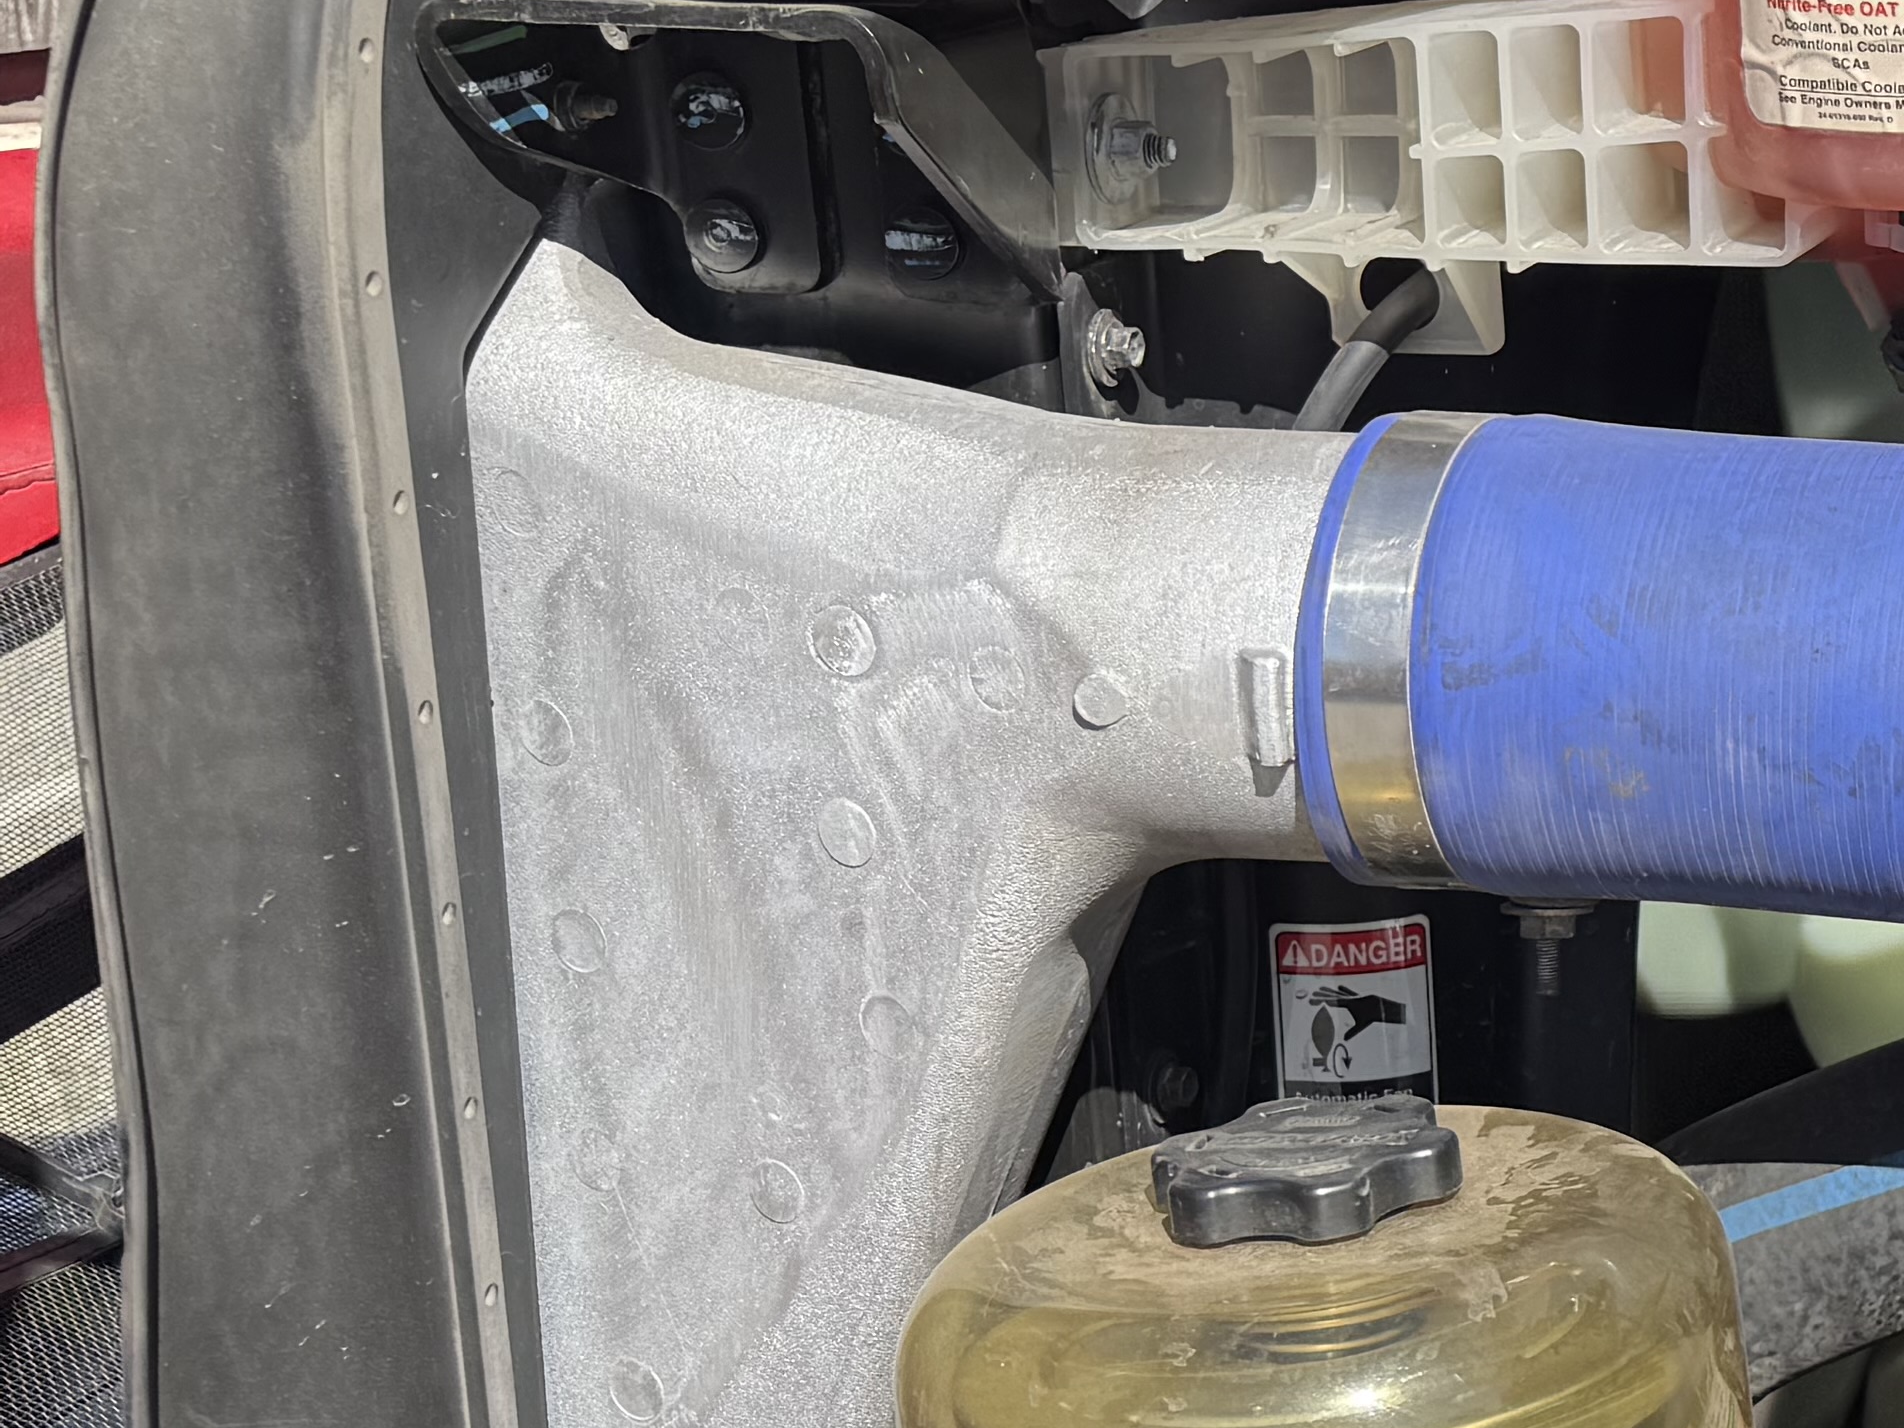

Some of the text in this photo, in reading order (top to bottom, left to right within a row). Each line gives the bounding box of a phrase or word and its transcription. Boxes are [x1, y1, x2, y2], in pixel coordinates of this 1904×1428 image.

[1859, 1, 1900, 18] OAT
[1784, 17, 1837, 34] Coolant.
[1840, 22, 1859, 35] Do
[1863, 23, 1889, 37] Not
[1771, 34, 1854, 53] Conventional
[1831, 56, 1871, 70] SCAs
[1779, 74, 1859, 93] Compatible
[1777, 91, 1798, 105] See
[1800, 93, 1841, 110] Engine
[1843, 97, 1892, 111] Owners
[1309, 934, 1422, 968] DANGER
